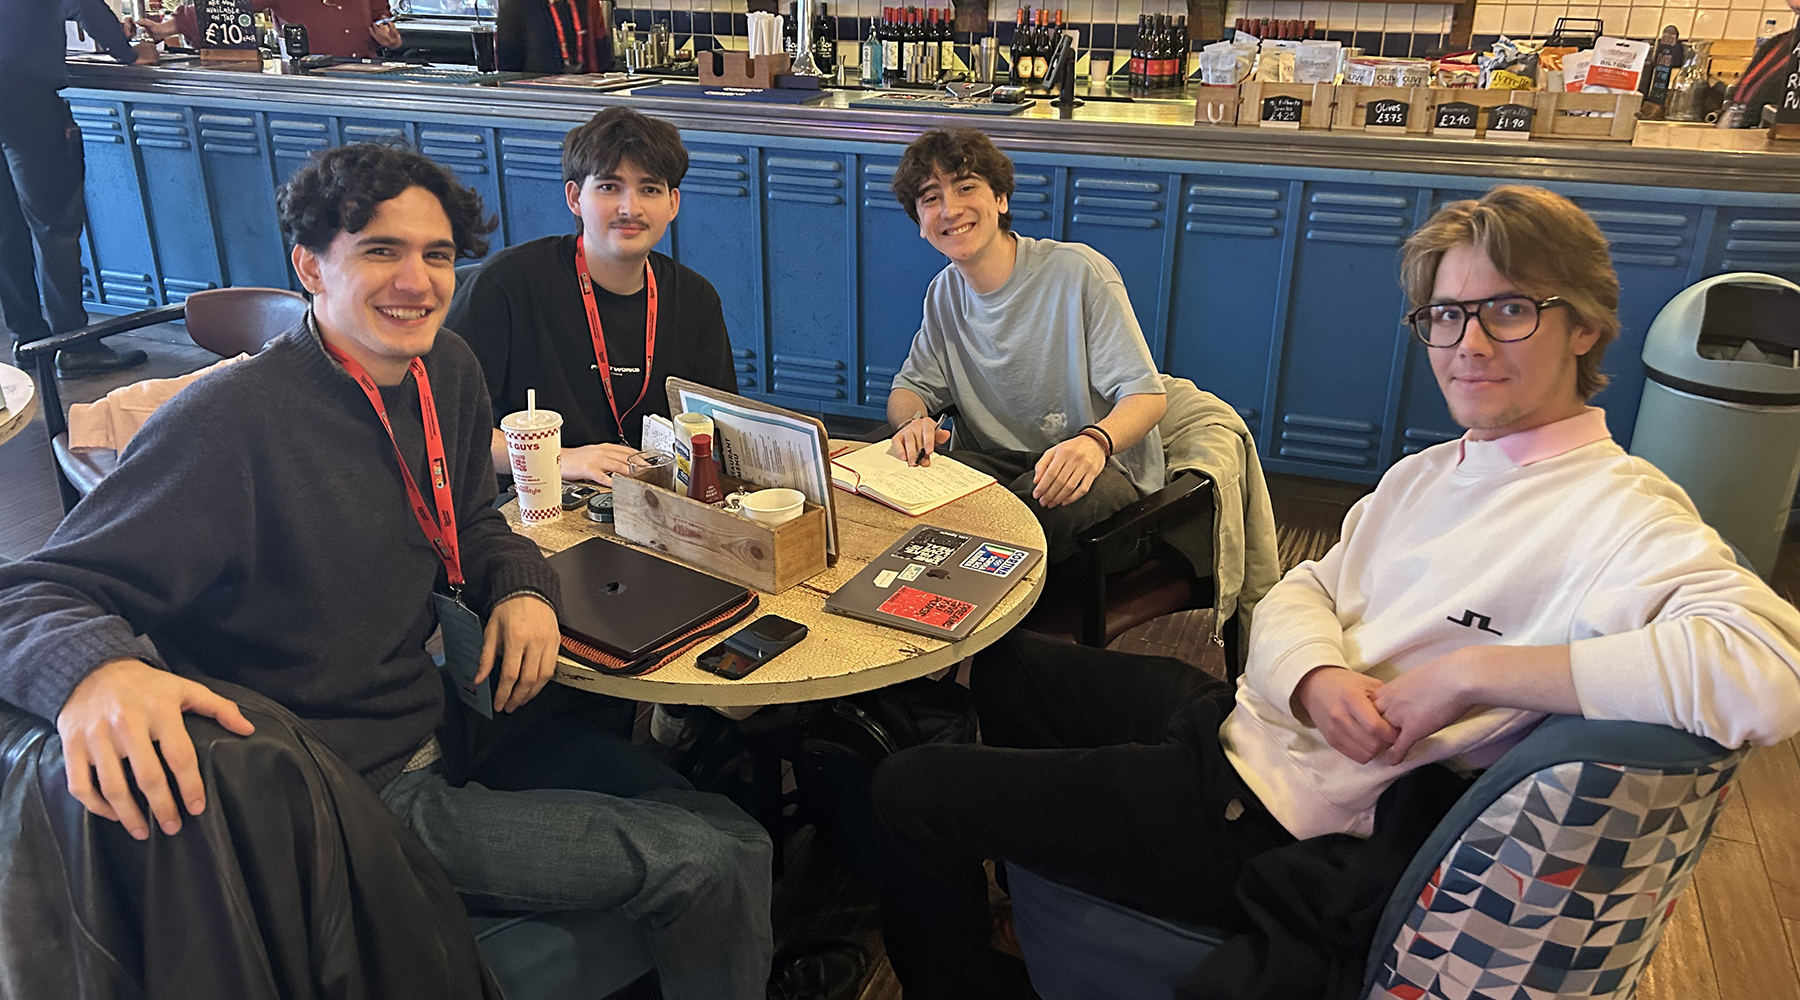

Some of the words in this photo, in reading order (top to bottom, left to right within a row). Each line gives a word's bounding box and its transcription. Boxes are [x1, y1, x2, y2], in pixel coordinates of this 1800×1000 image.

[205, 22, 243, 45] £10
[1600, 60, 1632, 69] BILTONG
[591, 364, 640, 373] PTWORKS
[733, 453, 743, 479] MENU
[994, 550, 1026, 576] CORTINA
[940, 602, 972, 628] DREAMS
